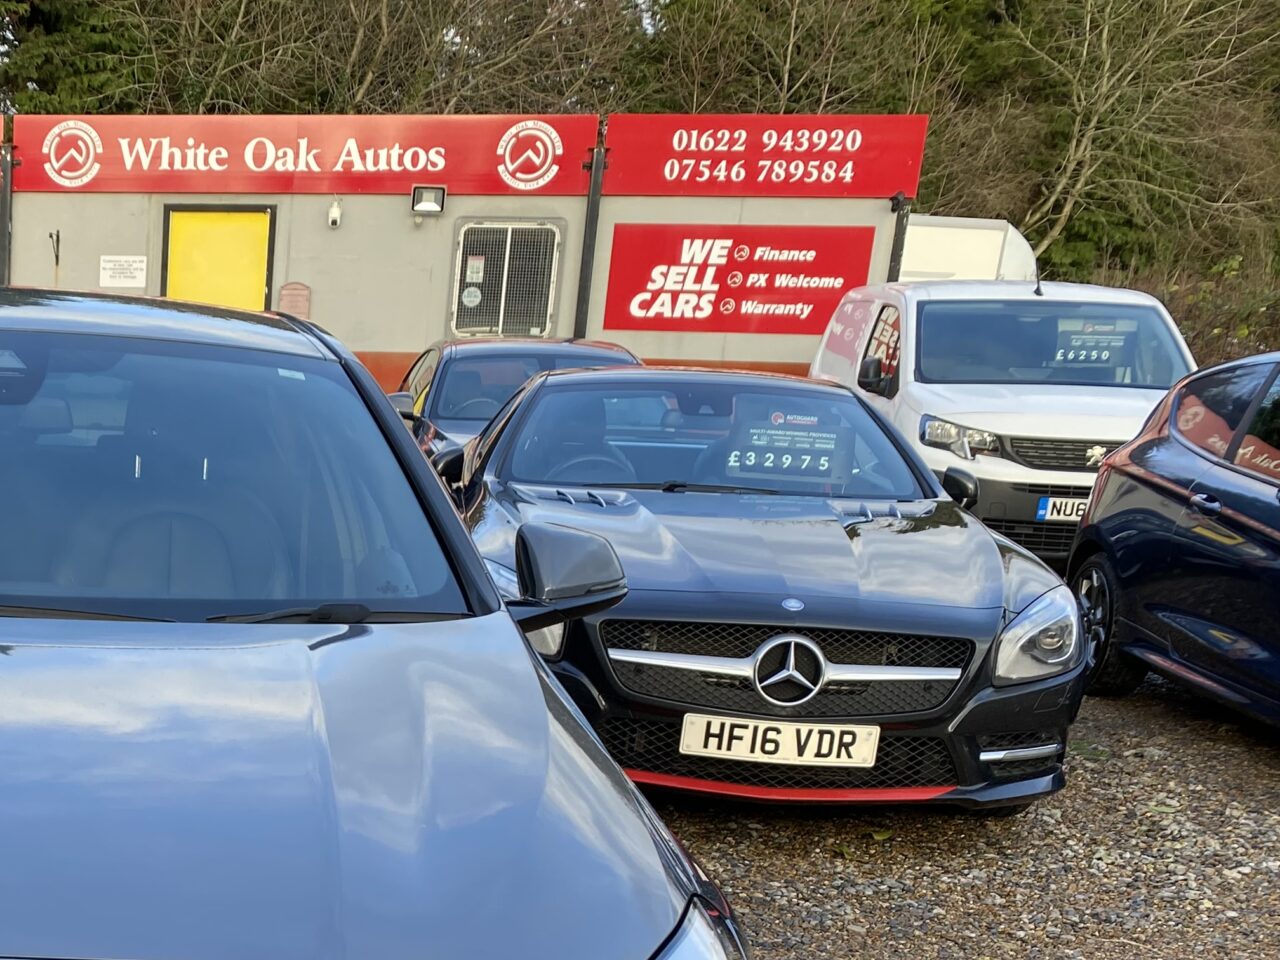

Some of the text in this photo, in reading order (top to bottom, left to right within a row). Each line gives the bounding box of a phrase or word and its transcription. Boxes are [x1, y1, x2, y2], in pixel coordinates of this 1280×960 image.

[672, 129, 863, 152] 01622 943920
[118, 136, 228, 171] White
[244, 136, 322, 172] Oak
[332, 136, 446, 172] Autos
[664, 158, 855, 183] 07546 789584
[680, 239, 733, 265] WE
[753, 246, 817, 262] Finance
[646, 265, 720, 292] SELL
[746, 273, 845, 289] PX Welcome
[629, 292, 716, 319] CARS
[740, 300, 814, 319] Warranty
[1056, 349, 1110, 361] £6250
[728, 451, 829, 470] £32975
[702, 720, 857, 759] HF16 VDR
